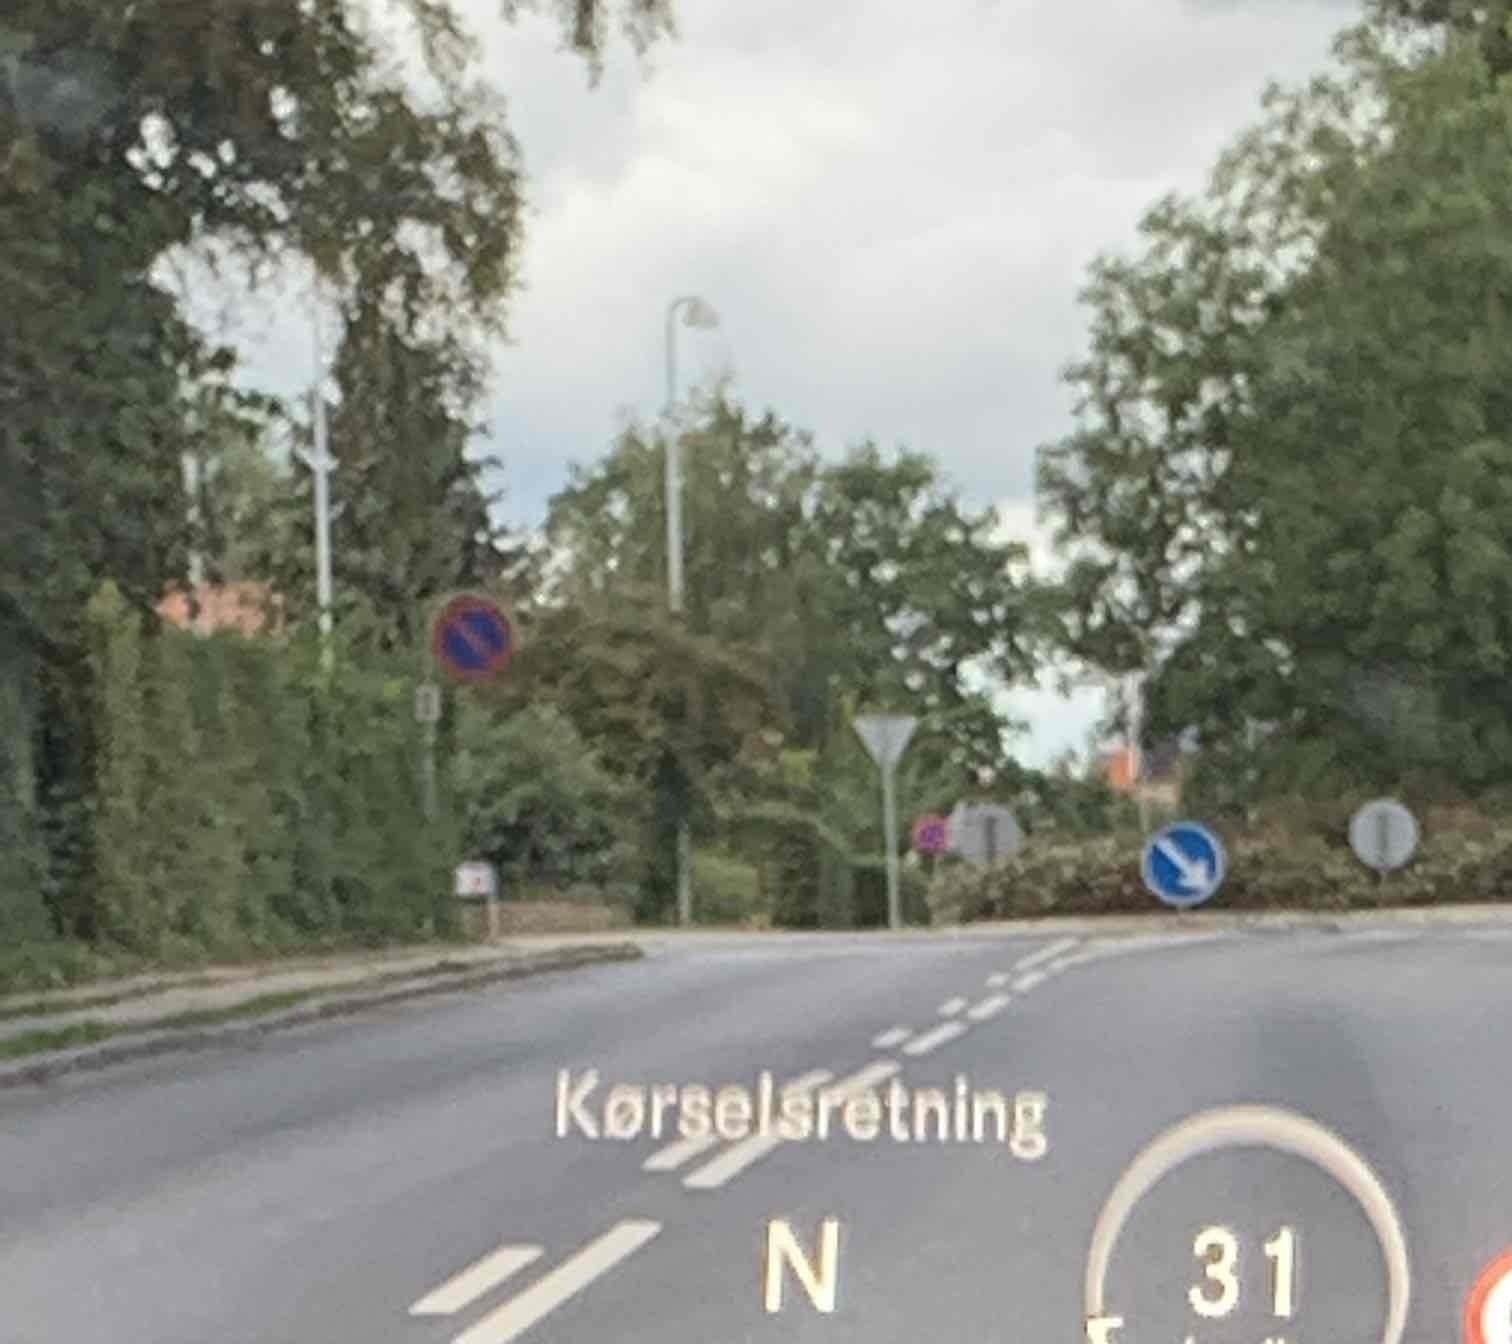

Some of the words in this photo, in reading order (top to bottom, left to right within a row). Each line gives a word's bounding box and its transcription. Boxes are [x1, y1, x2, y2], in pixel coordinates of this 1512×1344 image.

[555, 1068, 1049, 1160] Kørselsretning
[763, 1218, 840, 1312] N
[1189, 1226, 1298, 1317] 31
